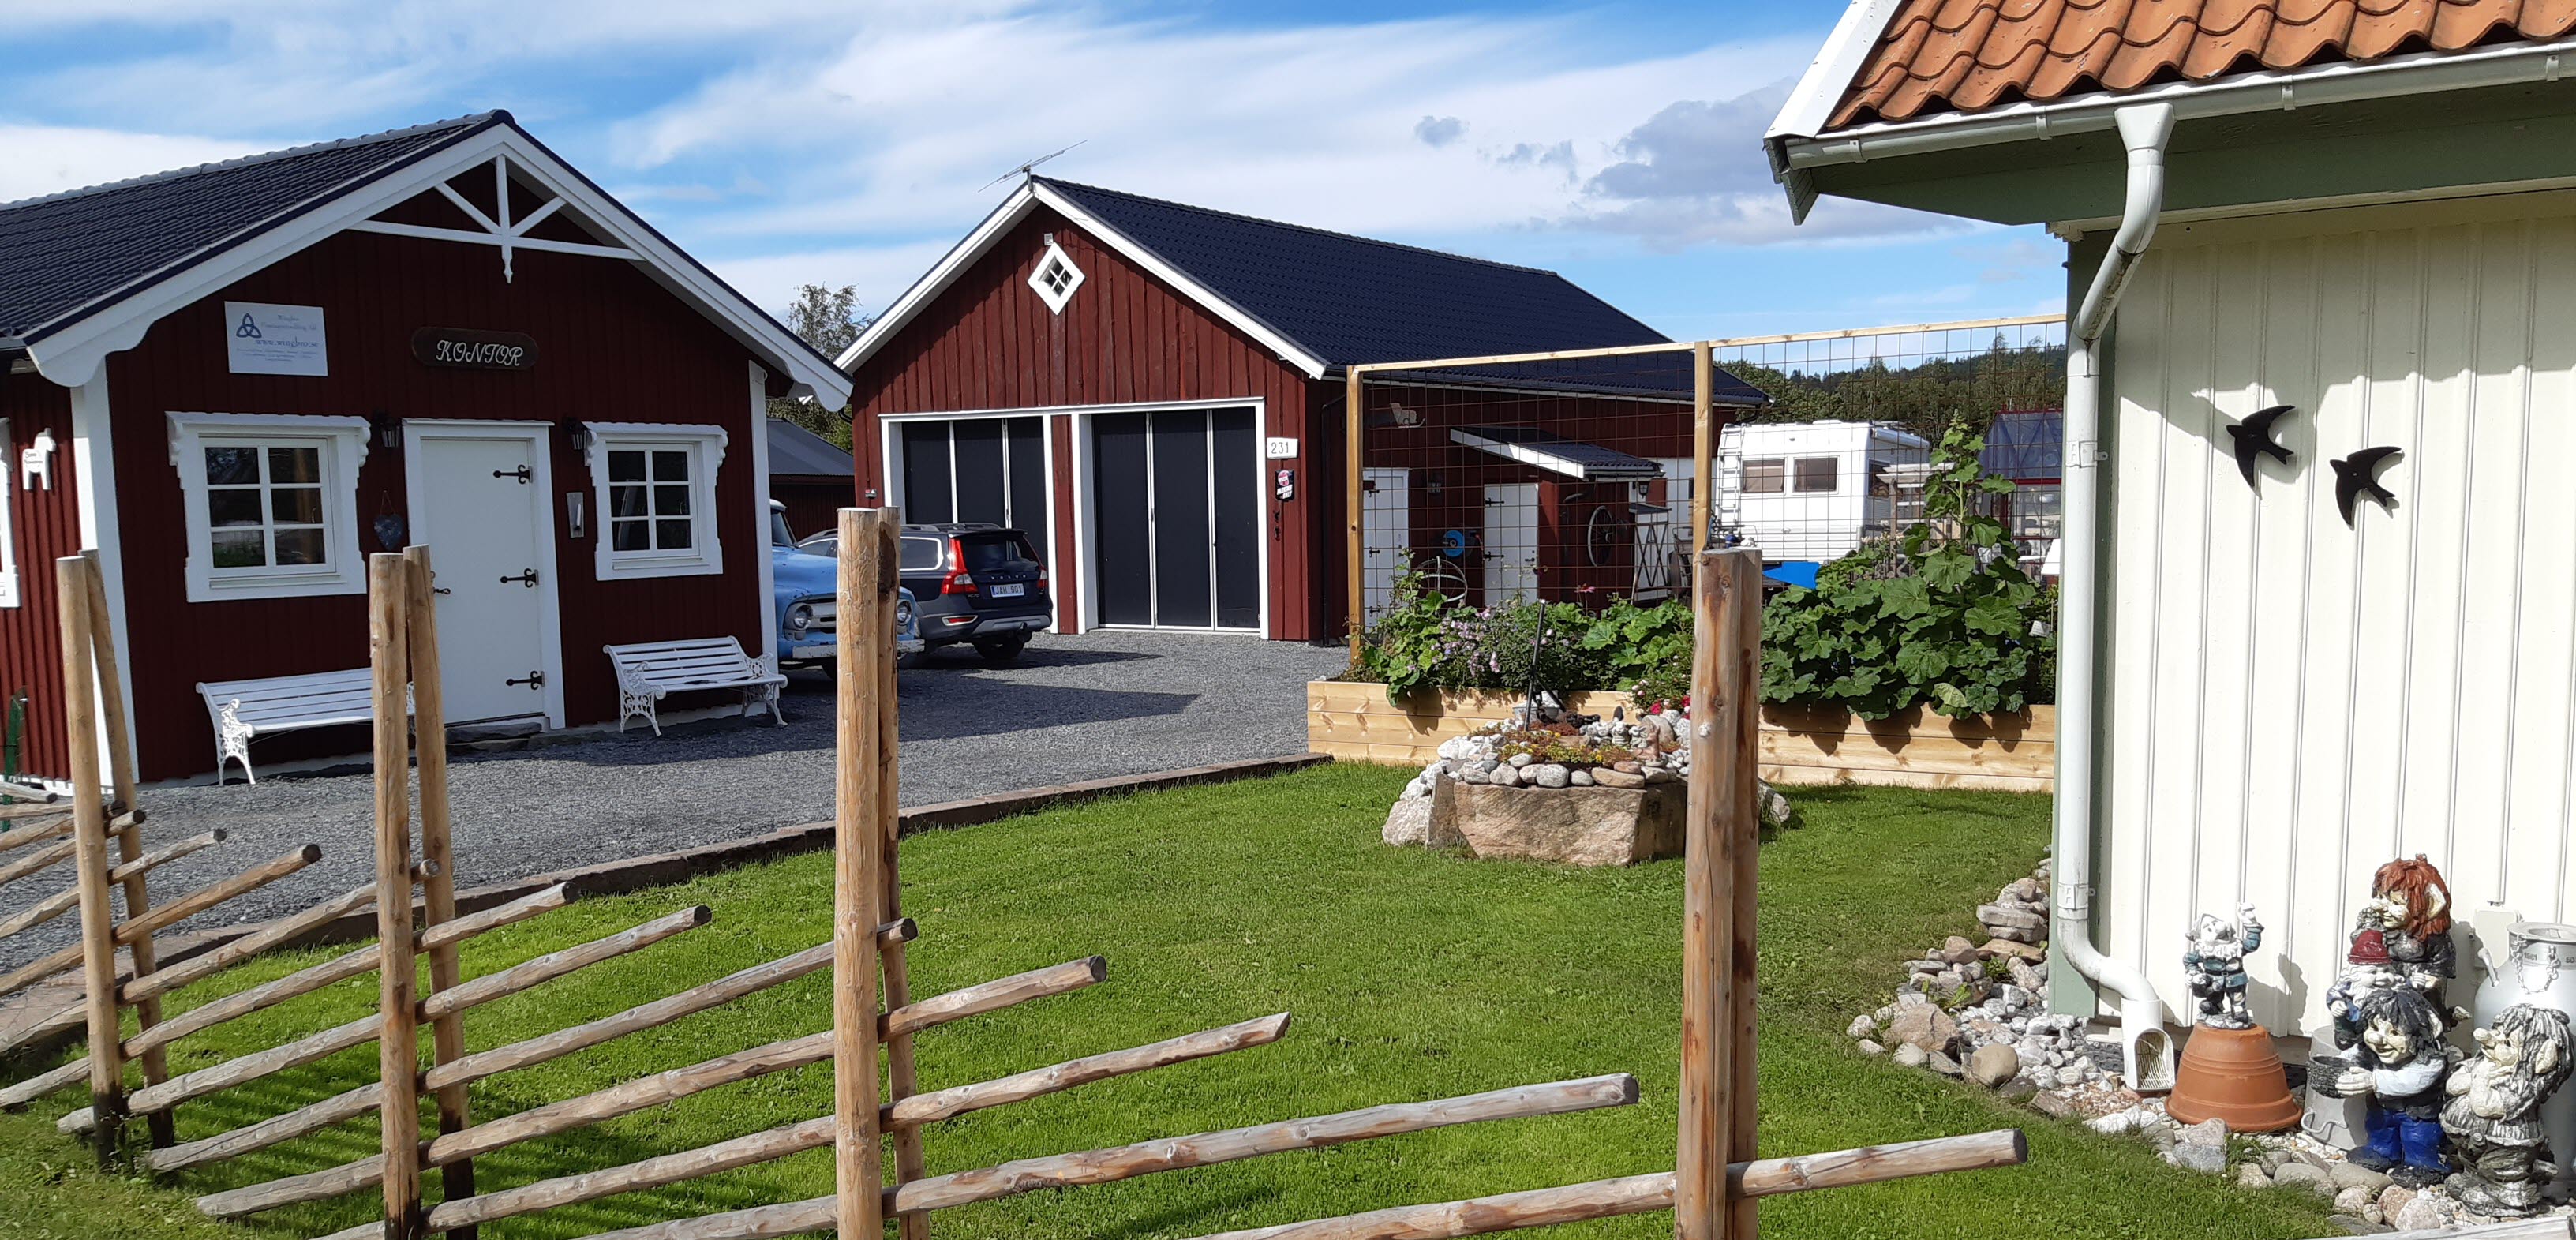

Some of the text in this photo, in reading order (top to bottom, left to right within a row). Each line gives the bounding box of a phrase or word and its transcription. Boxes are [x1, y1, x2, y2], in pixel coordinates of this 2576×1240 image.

[255, 335, 319, 347] www.wingbro.se
[436, 339, 523, 366] KONTOR
[1271, 442, 1289, 455] 231
